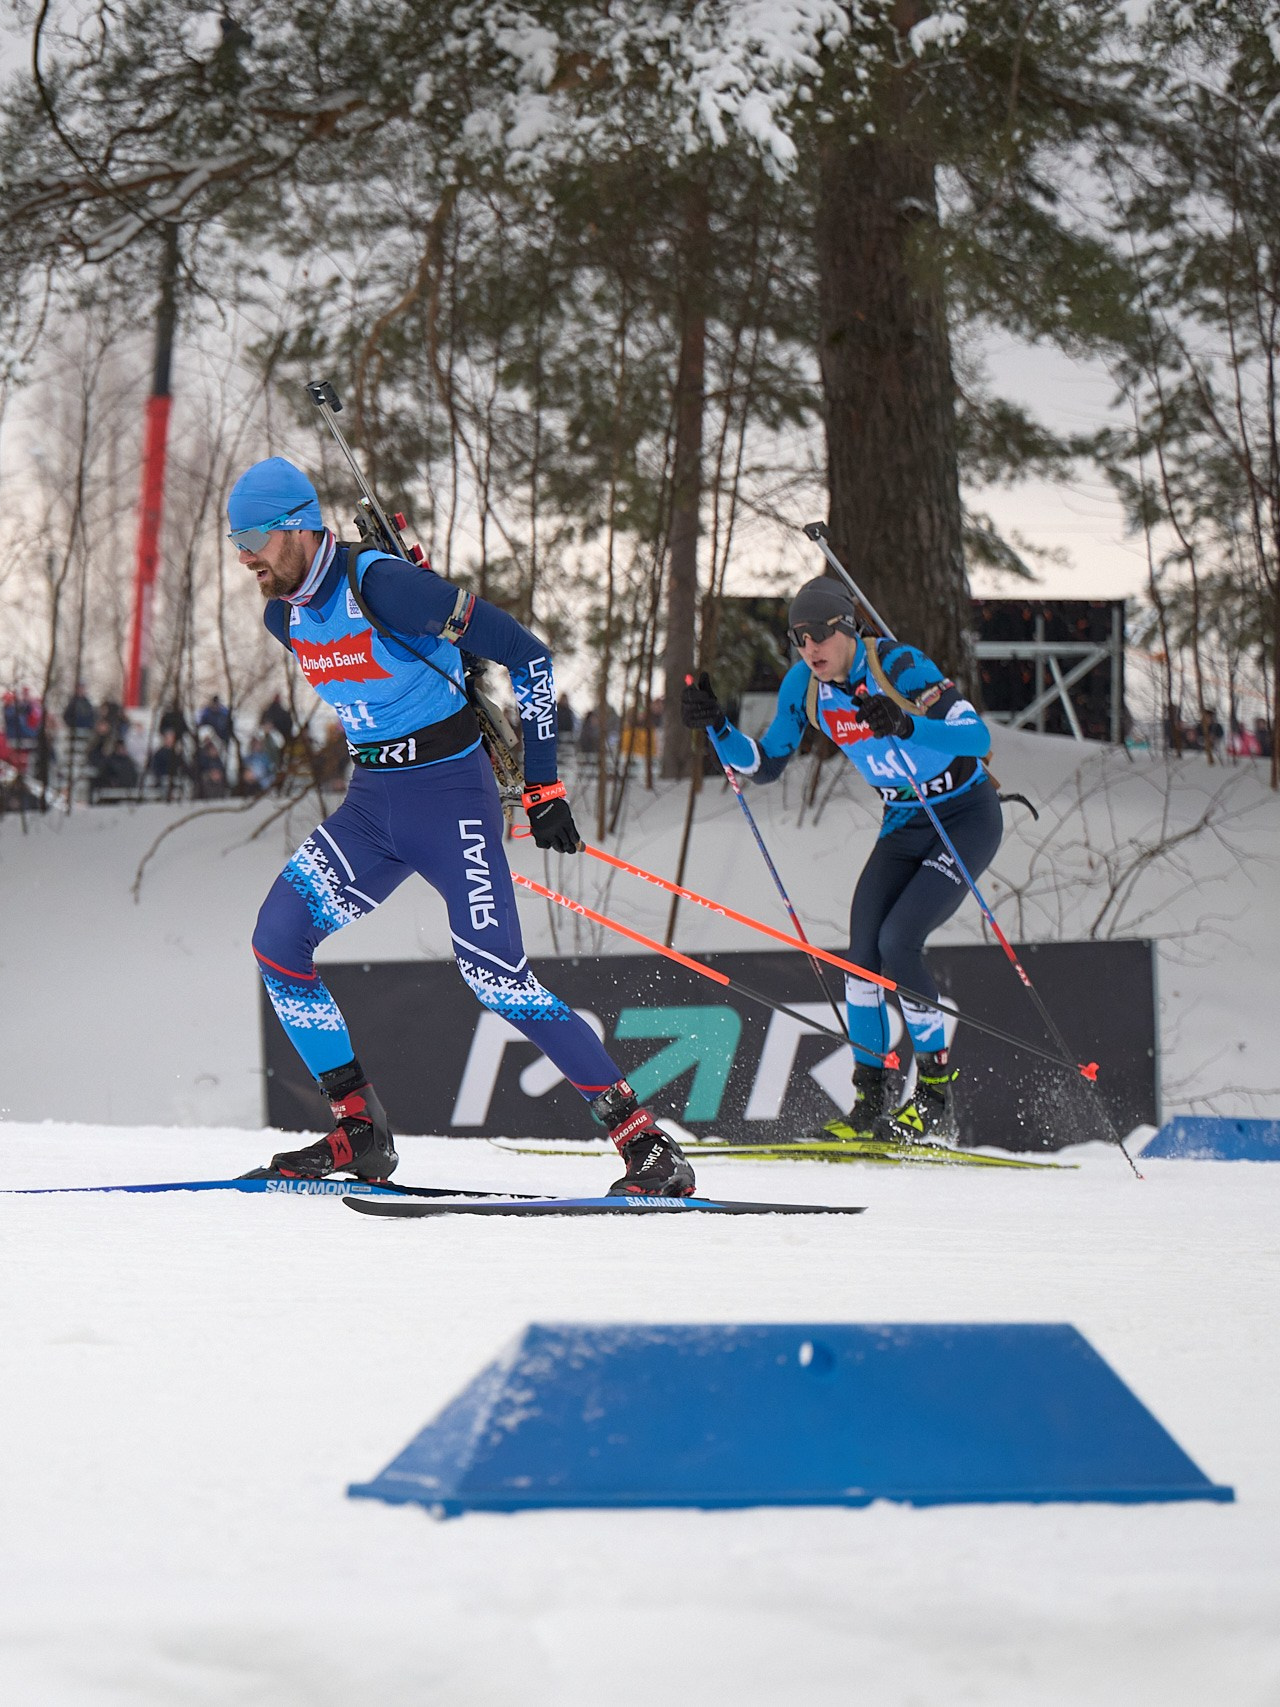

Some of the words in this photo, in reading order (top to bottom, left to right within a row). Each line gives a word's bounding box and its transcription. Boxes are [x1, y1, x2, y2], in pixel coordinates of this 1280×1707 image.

[302, 654, 333, 672] Альфа
[334, 651, 368, 665] Банк
[528, 656, 556, 740] ЯМАЛ
[458, 819, 499, 931] ЯМАЛ
[613, 1114, 648, 1144] MADSHUS
[265, 1180, 351, 1195] SALOMON
[625, 1196, 687, 1208] SALOMON
